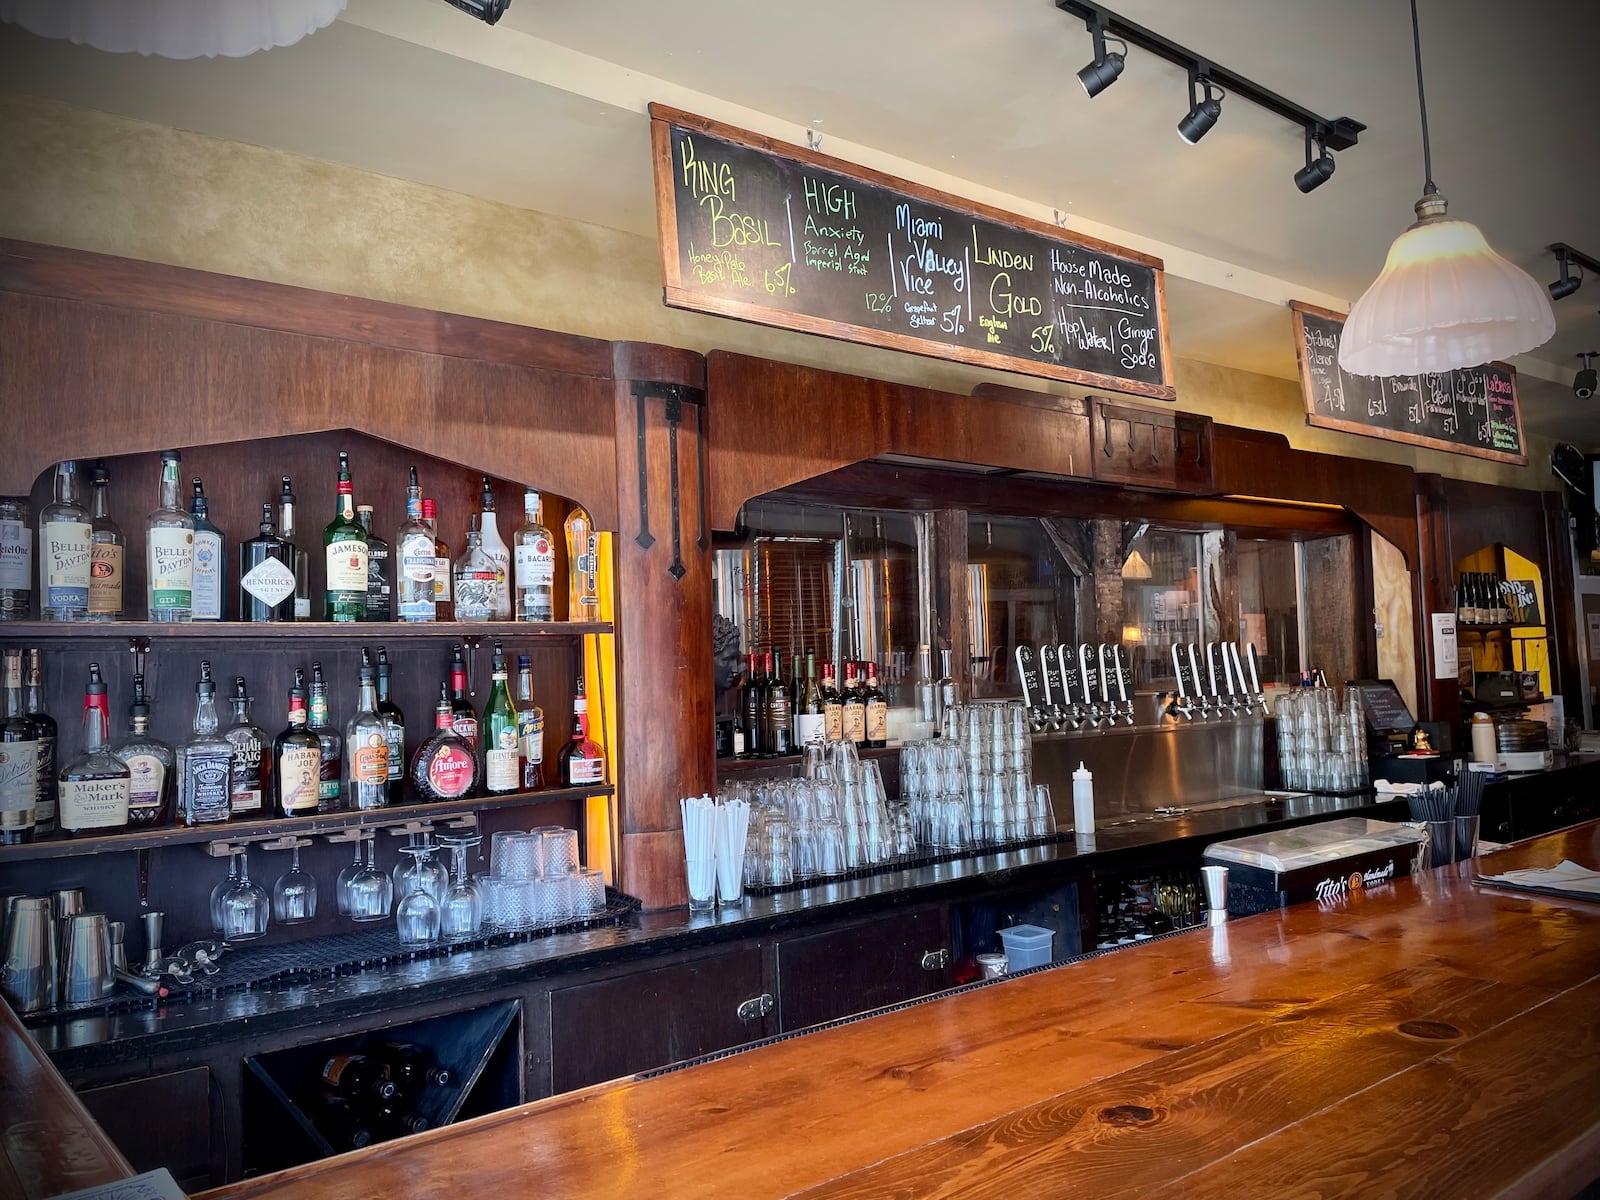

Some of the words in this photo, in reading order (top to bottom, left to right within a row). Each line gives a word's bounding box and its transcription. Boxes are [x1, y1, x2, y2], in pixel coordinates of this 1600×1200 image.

[681, 136, 736, 201] KING
[804, 176, 857, 219] HIGH
[804, 214, 864, 246] Anxiety
[896, 204, 943, 243] Miami
[687, 241, 722, 265] Honey
[804, 240, 837, 257] Barrel
[805, 255, 842, 271] Imperial
[1051, 249, 1086, 277] House
[1089, 260, 1132, 288] Made
[732, 271, 751, 288] Ale
[989, 272, 1042, 318] GOLD
[1054, 278, 1150, 309] Non-Alcoholics
[866, 293, 893, 313] 12%
[940, 305, 964, 335] 5%
[1057, 306, 1080, 345] Hop
[1030, 324, 1054, 353] 5%
[1117, 318, 1157, 354] Ginger
[1120, 344, 1156, 369] Soda
[0, 545, 14, 554] etel
[15, 545, 28, 555] One
[51, 541, 85, 553] BELLE
[91, 548, 118, 558] ito's
[155, 546, 188, 558] BELLE
[332, 544, 368, 555] JAMESO
[56, 553, 90, 570] DAYTON
[160, 557, 192, 574] DAYTON
[1518, 592, 1534, 608] IN!
[192, 763, 207, 774] JACK
[207, 761, 229, 773] DANIEL'S
[434, 760, 468, 774] Amore
[74, 783, 126, 792] Maker's
[89, 792, 123, 802] Mark
[1316, 876, 1347, 900] Tito's
